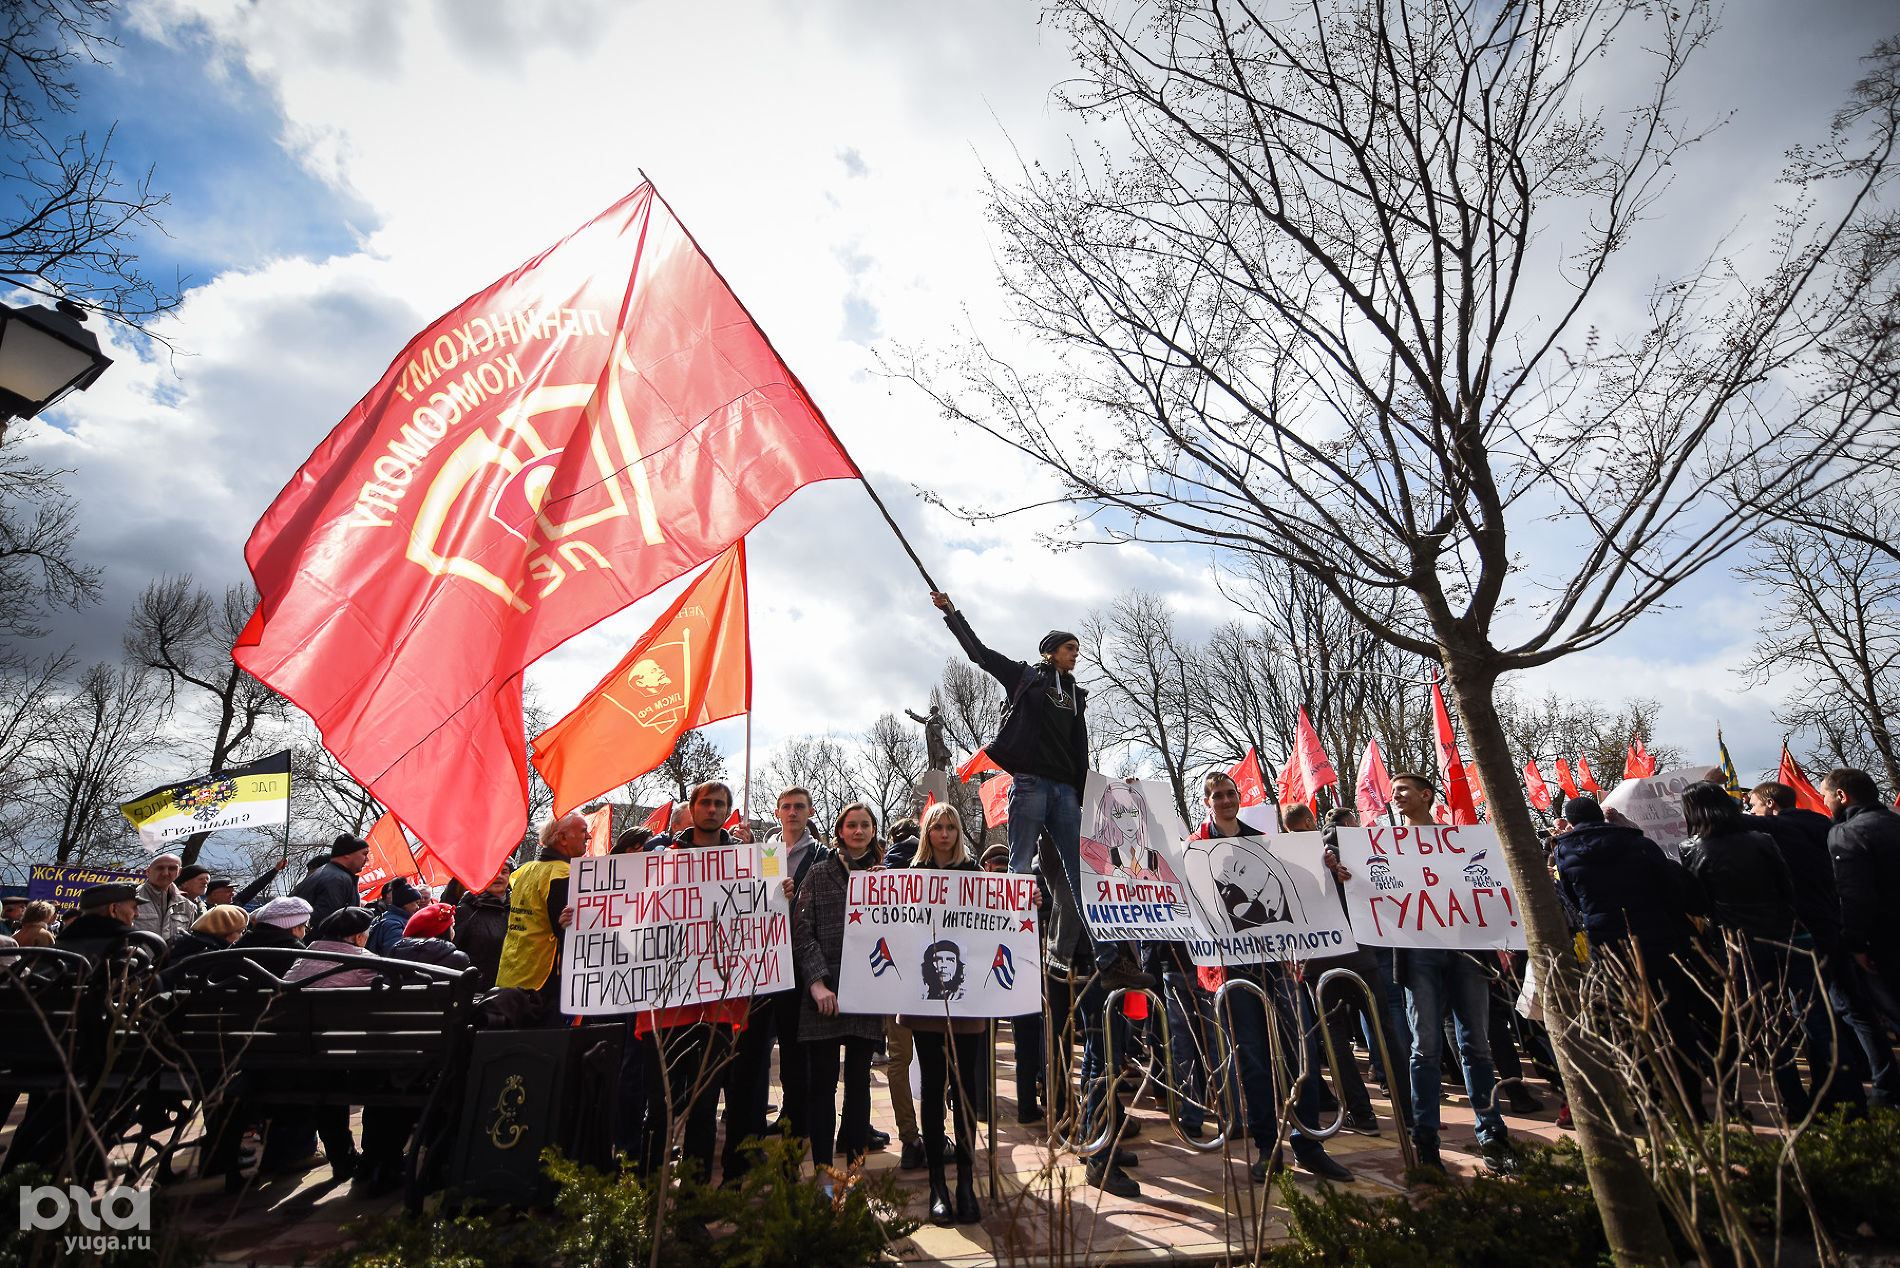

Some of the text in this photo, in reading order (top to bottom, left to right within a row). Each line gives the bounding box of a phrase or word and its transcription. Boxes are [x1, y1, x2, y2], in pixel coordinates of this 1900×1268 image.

[1367, 826, 1466, 855] КРЫС
[32, 865, 67, 881] ЖСК
[68, 870, 109, 884] «Наш
[578, 858, 626, 893] ЕШЬ
[1422, 866, 1440, 887] В
[55, 885, 63, 896] 6
[850, 874, 1036, 912] LIBERTAD DE INTERNET
[1097, 881, 1177, 903] Я ПРОТИВ
[575, 886, 703, 931] РЯБЧИКОВ
[1087, 904, 1175, 923] ИНТЕРНЕТ
[1369, 887, 1518, 937] ГУЛАГ!
[573, 912, 787, 970] ДЕНЬ ТВОЙ ПОСЛЕДНИЙ
[1188, 934, 1275, 957] МОЛЧАНИЕ
